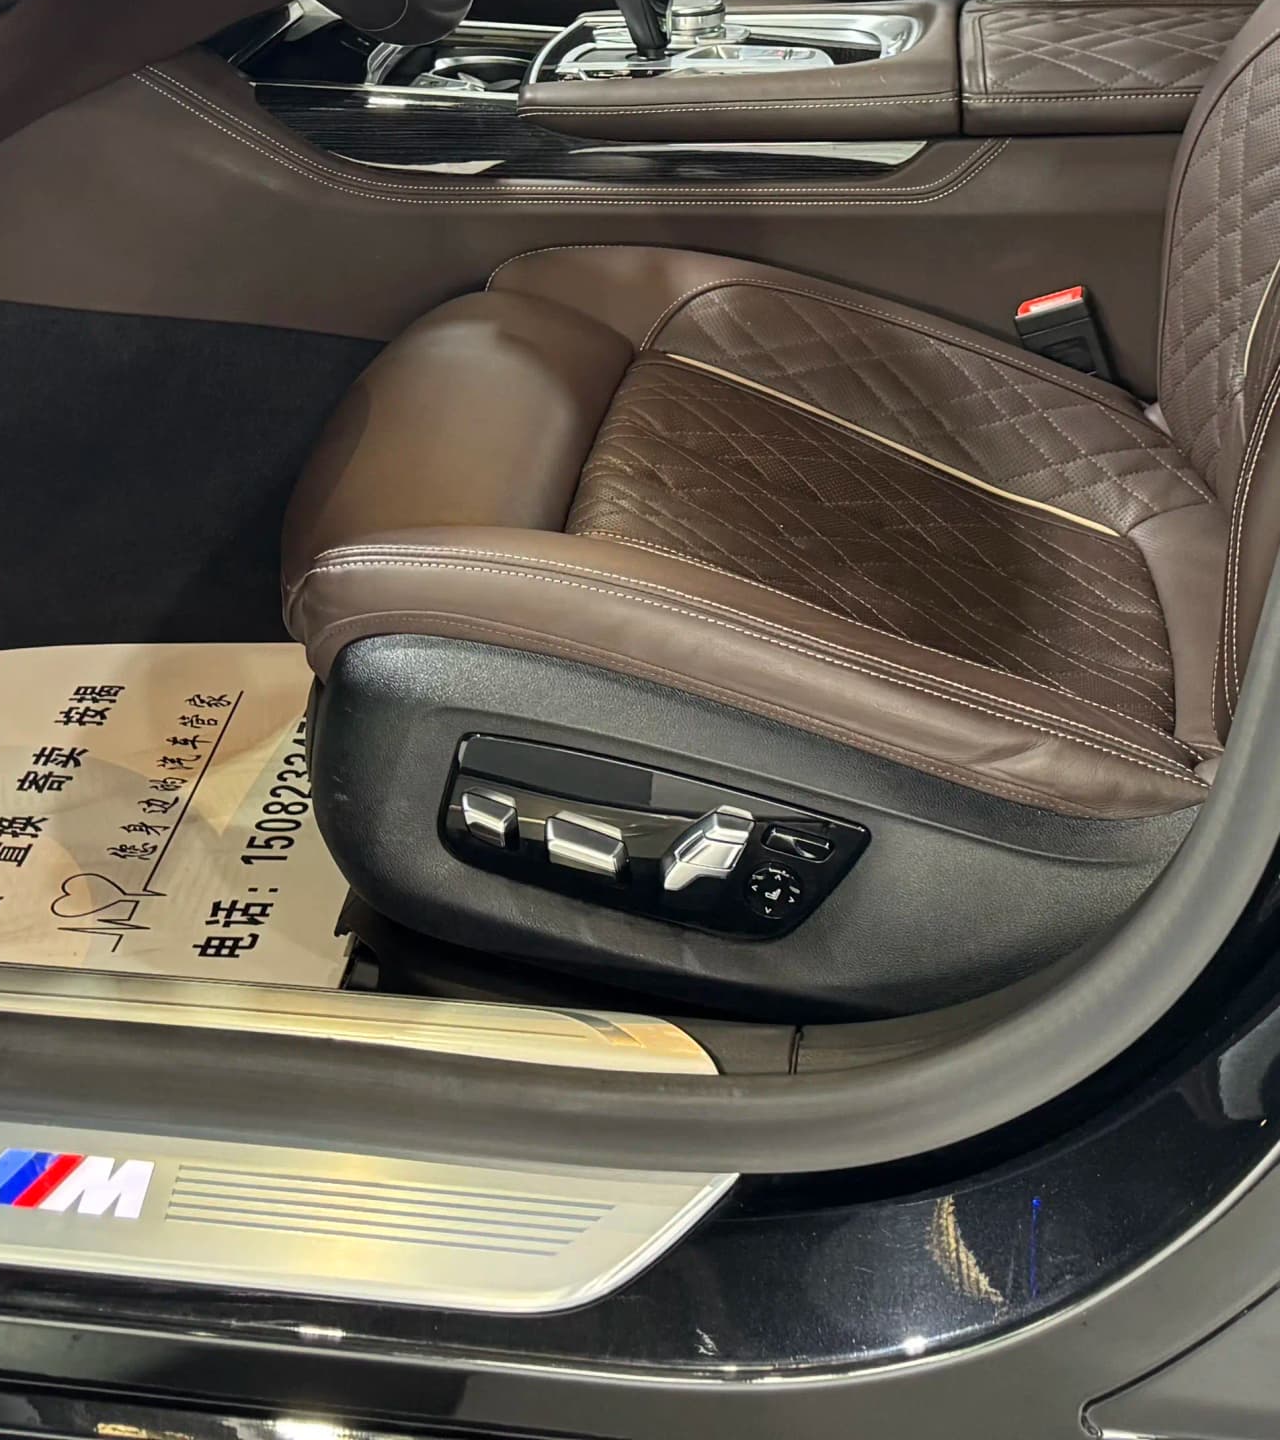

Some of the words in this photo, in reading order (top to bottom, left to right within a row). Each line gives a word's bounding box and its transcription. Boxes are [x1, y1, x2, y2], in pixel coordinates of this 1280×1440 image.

[15, 746, 89, 794] 寄卖
[54, 685, 126, 727] 按揭
[107, 693, 233, 861] 您身边的汽车管家
